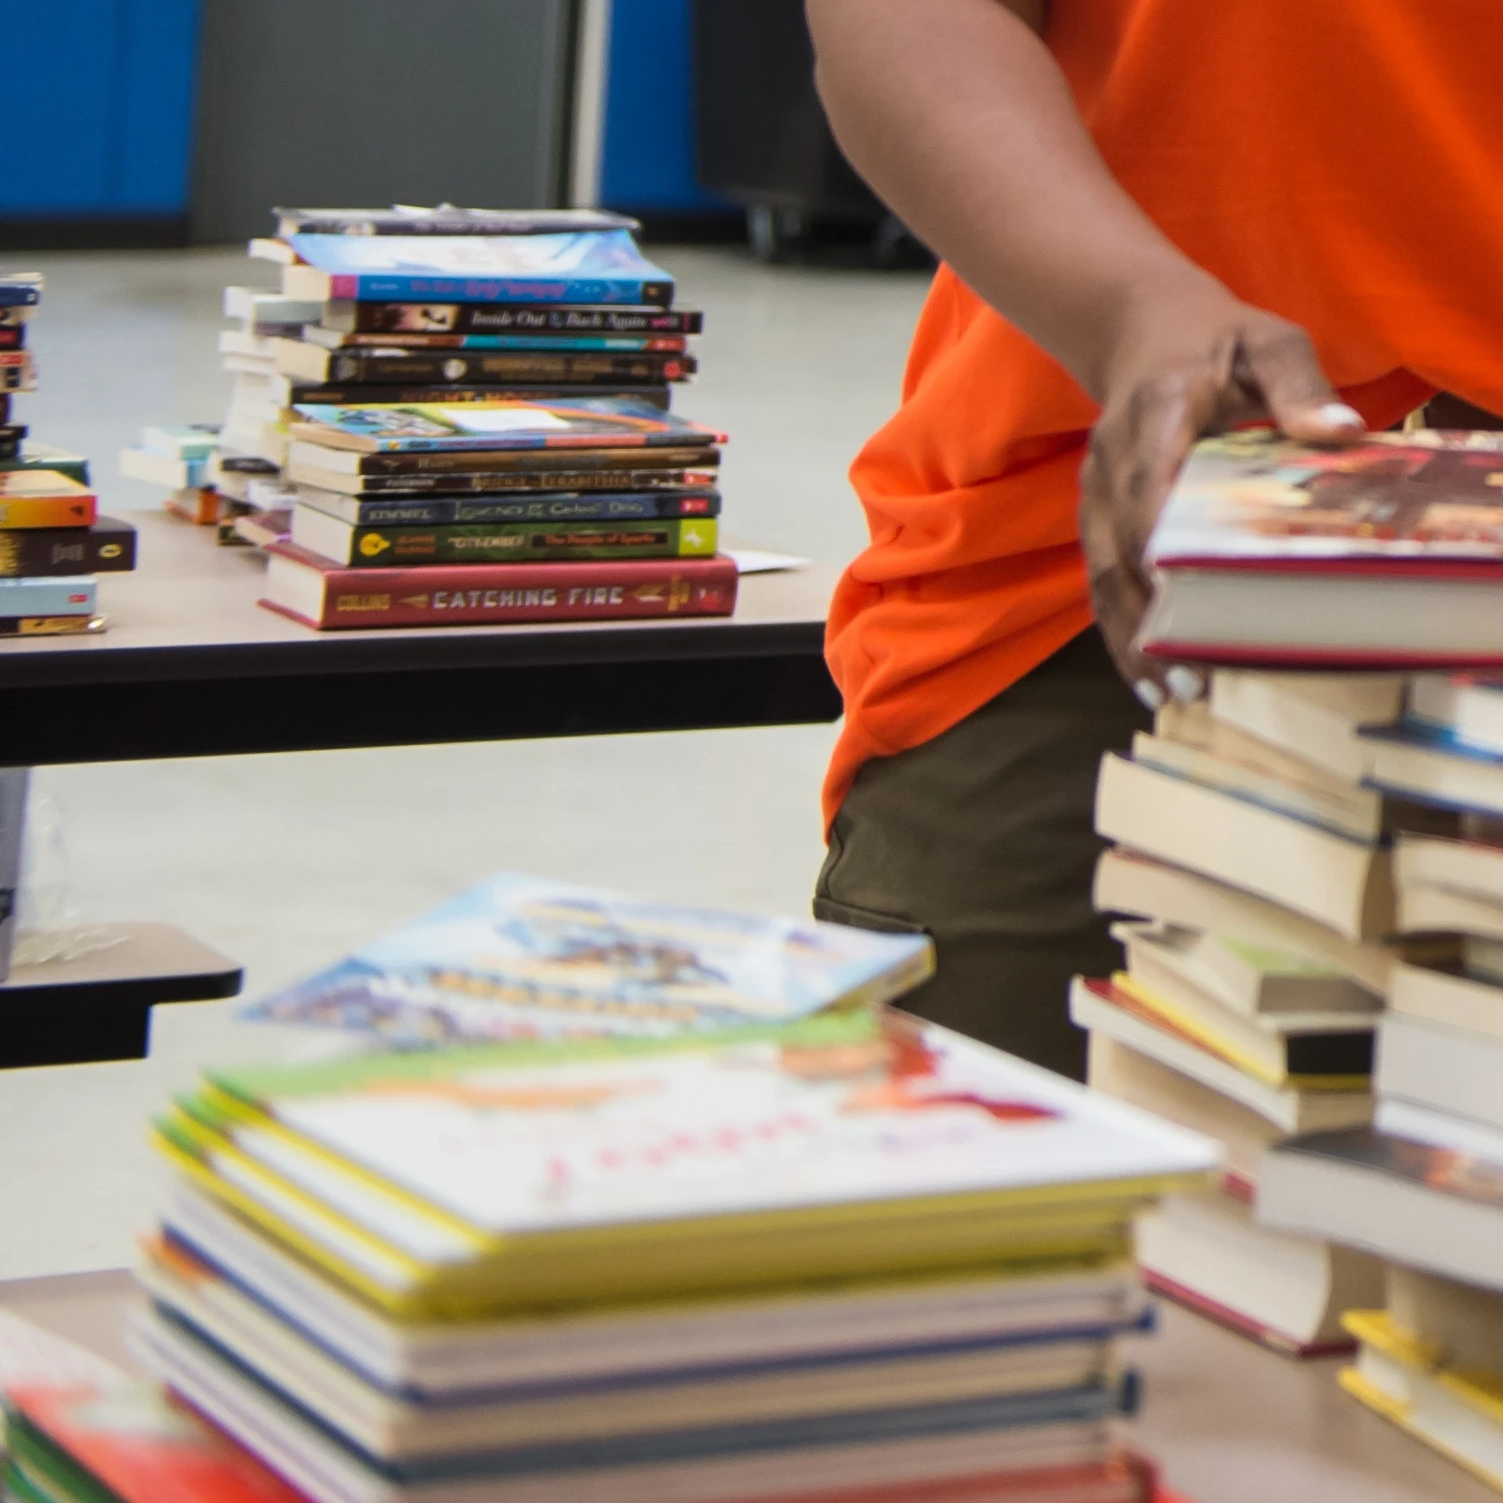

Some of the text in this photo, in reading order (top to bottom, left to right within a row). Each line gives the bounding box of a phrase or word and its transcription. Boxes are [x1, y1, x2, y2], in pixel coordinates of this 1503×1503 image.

[471, 309, 512, 326] Inside
[515, 310, 545, 326] Out
[606, 312, 648, 330] Again
[433, 588, 556, 610] CATCHING
[567, 585, 625, 605] FIRE
